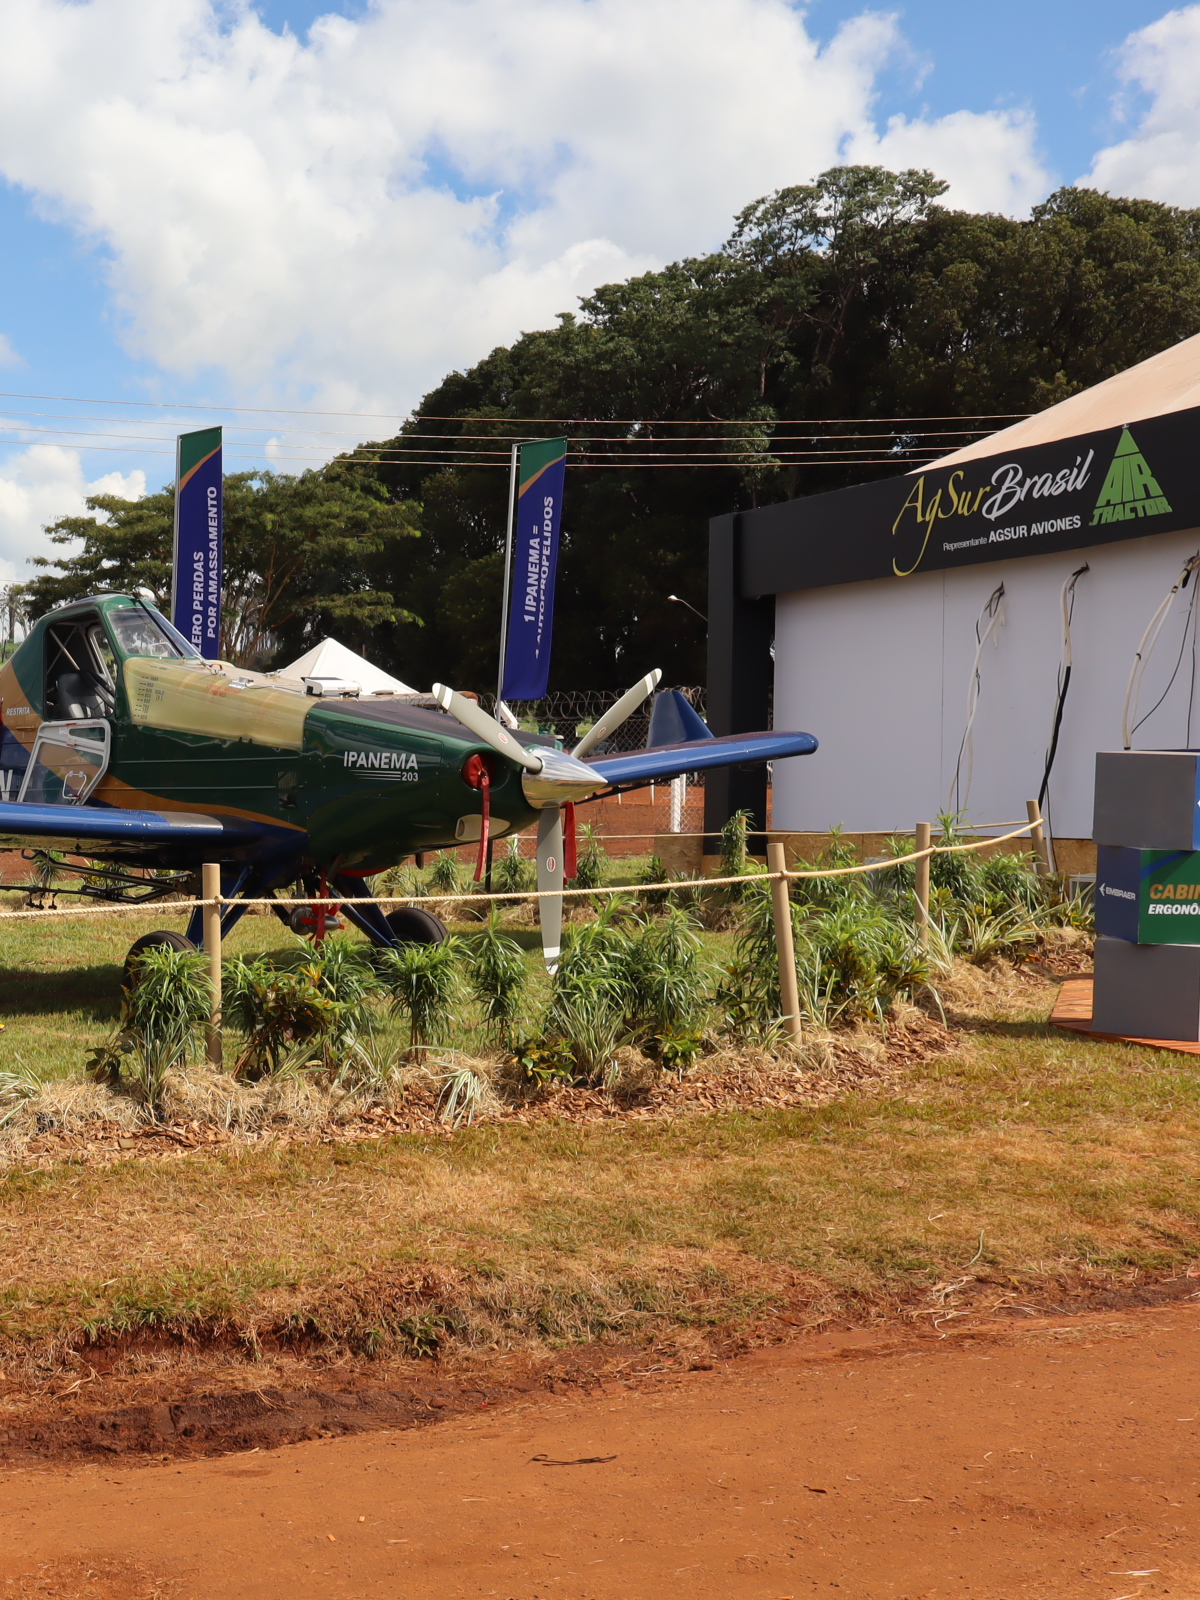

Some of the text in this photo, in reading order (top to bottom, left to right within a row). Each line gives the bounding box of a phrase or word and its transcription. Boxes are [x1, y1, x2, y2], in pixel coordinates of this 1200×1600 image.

[1090, 496, 1173, 525] TRACTOR
[943, 515, 1081, 551] Representante AGSUR AVIONES
[207, 486, 218, 638] POR AMASSAMENTO
[193, 551, 204, 611] PERDAS
[525, 538, 540, 612] IPANEMA
[524, 614, 535, 622] 1
[6, 707, 30, 715] RESTRITA
[344, 751, 418, 770] IPANEMA
[402, 772, 418, 781] 203
[1106, 888, 1136, 900] EMBRAER
[1148, 902, 1200, 915] ERGONÔ
